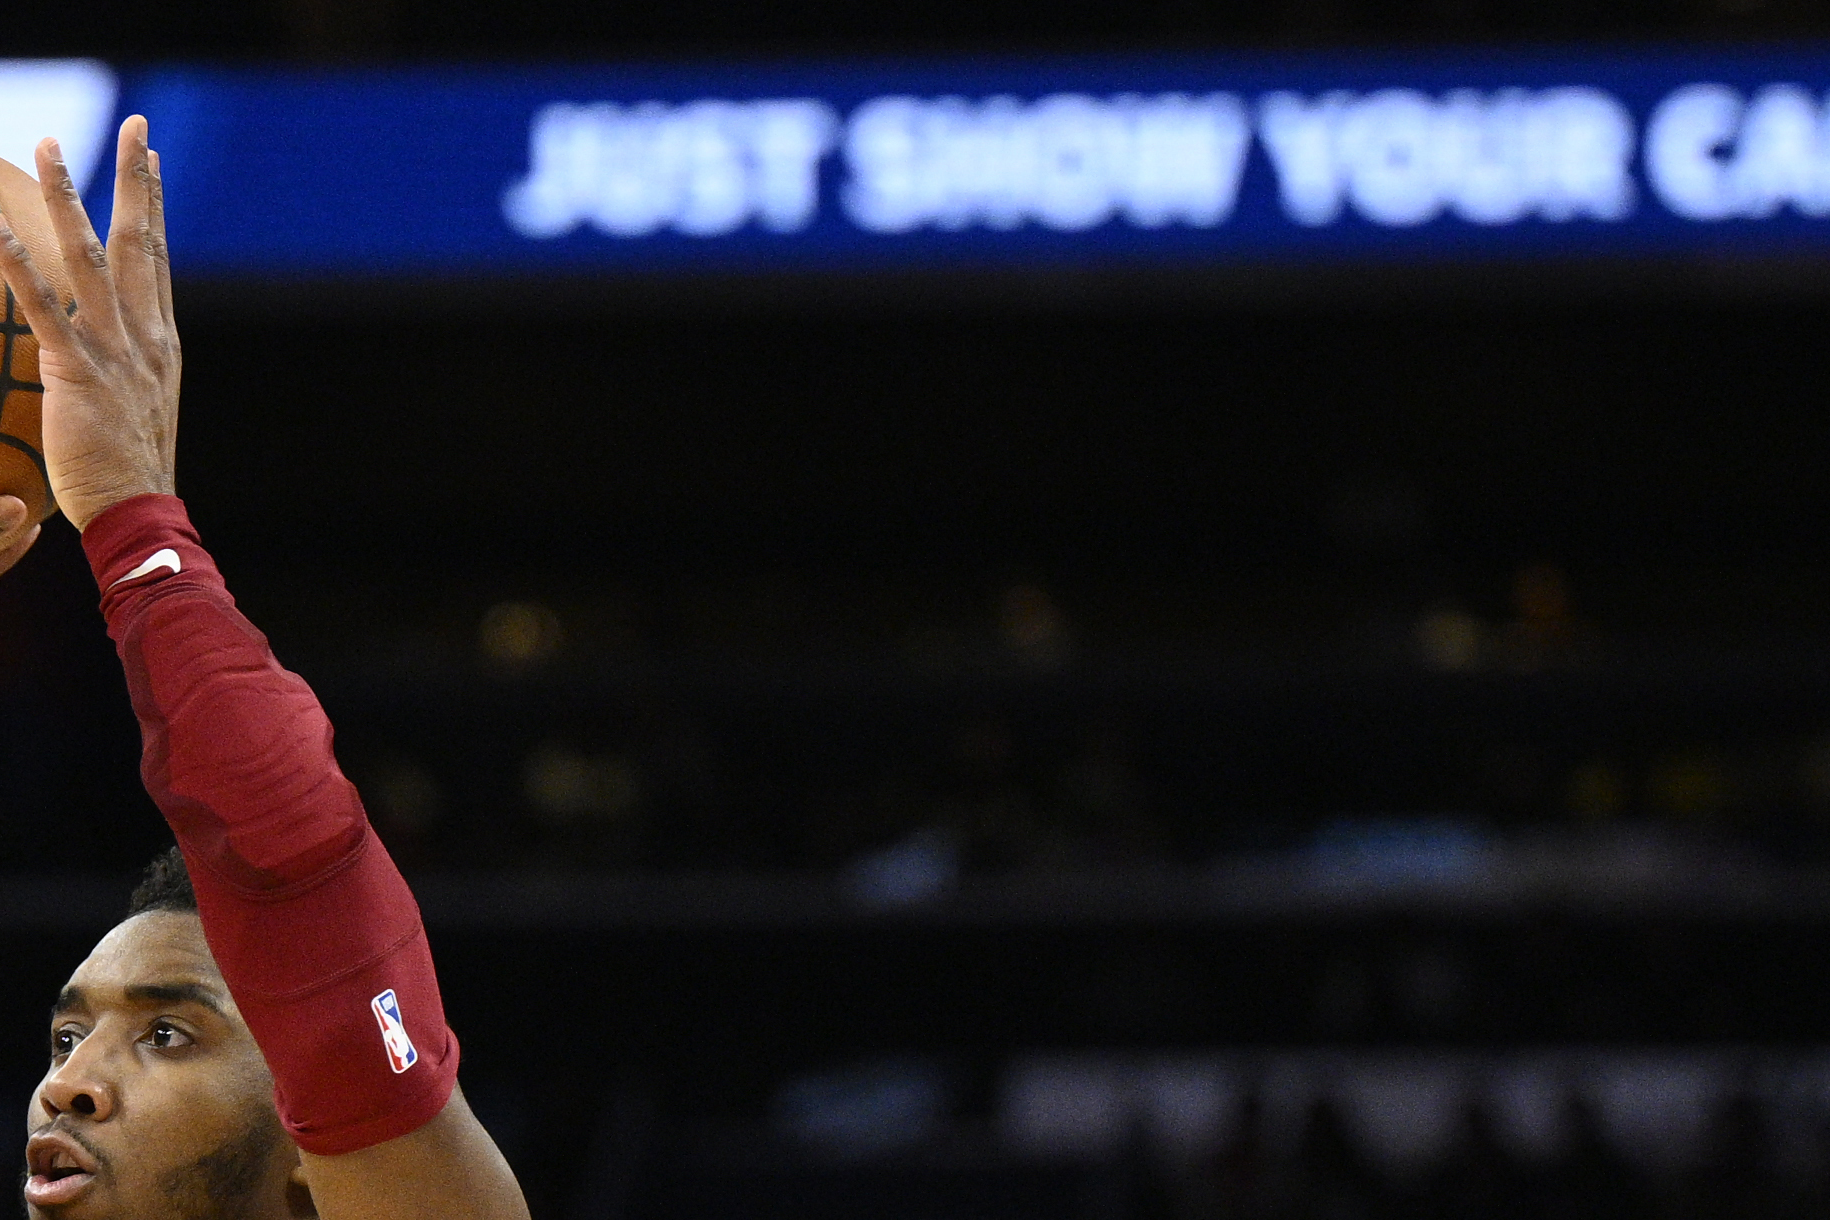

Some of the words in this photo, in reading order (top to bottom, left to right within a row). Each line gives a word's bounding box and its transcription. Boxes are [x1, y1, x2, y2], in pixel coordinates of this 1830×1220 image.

[504, 100, 836, 237] JUST
[842, 94, 1248, 230] SHOW
[1260, 88, 1636, 227] YOUR
